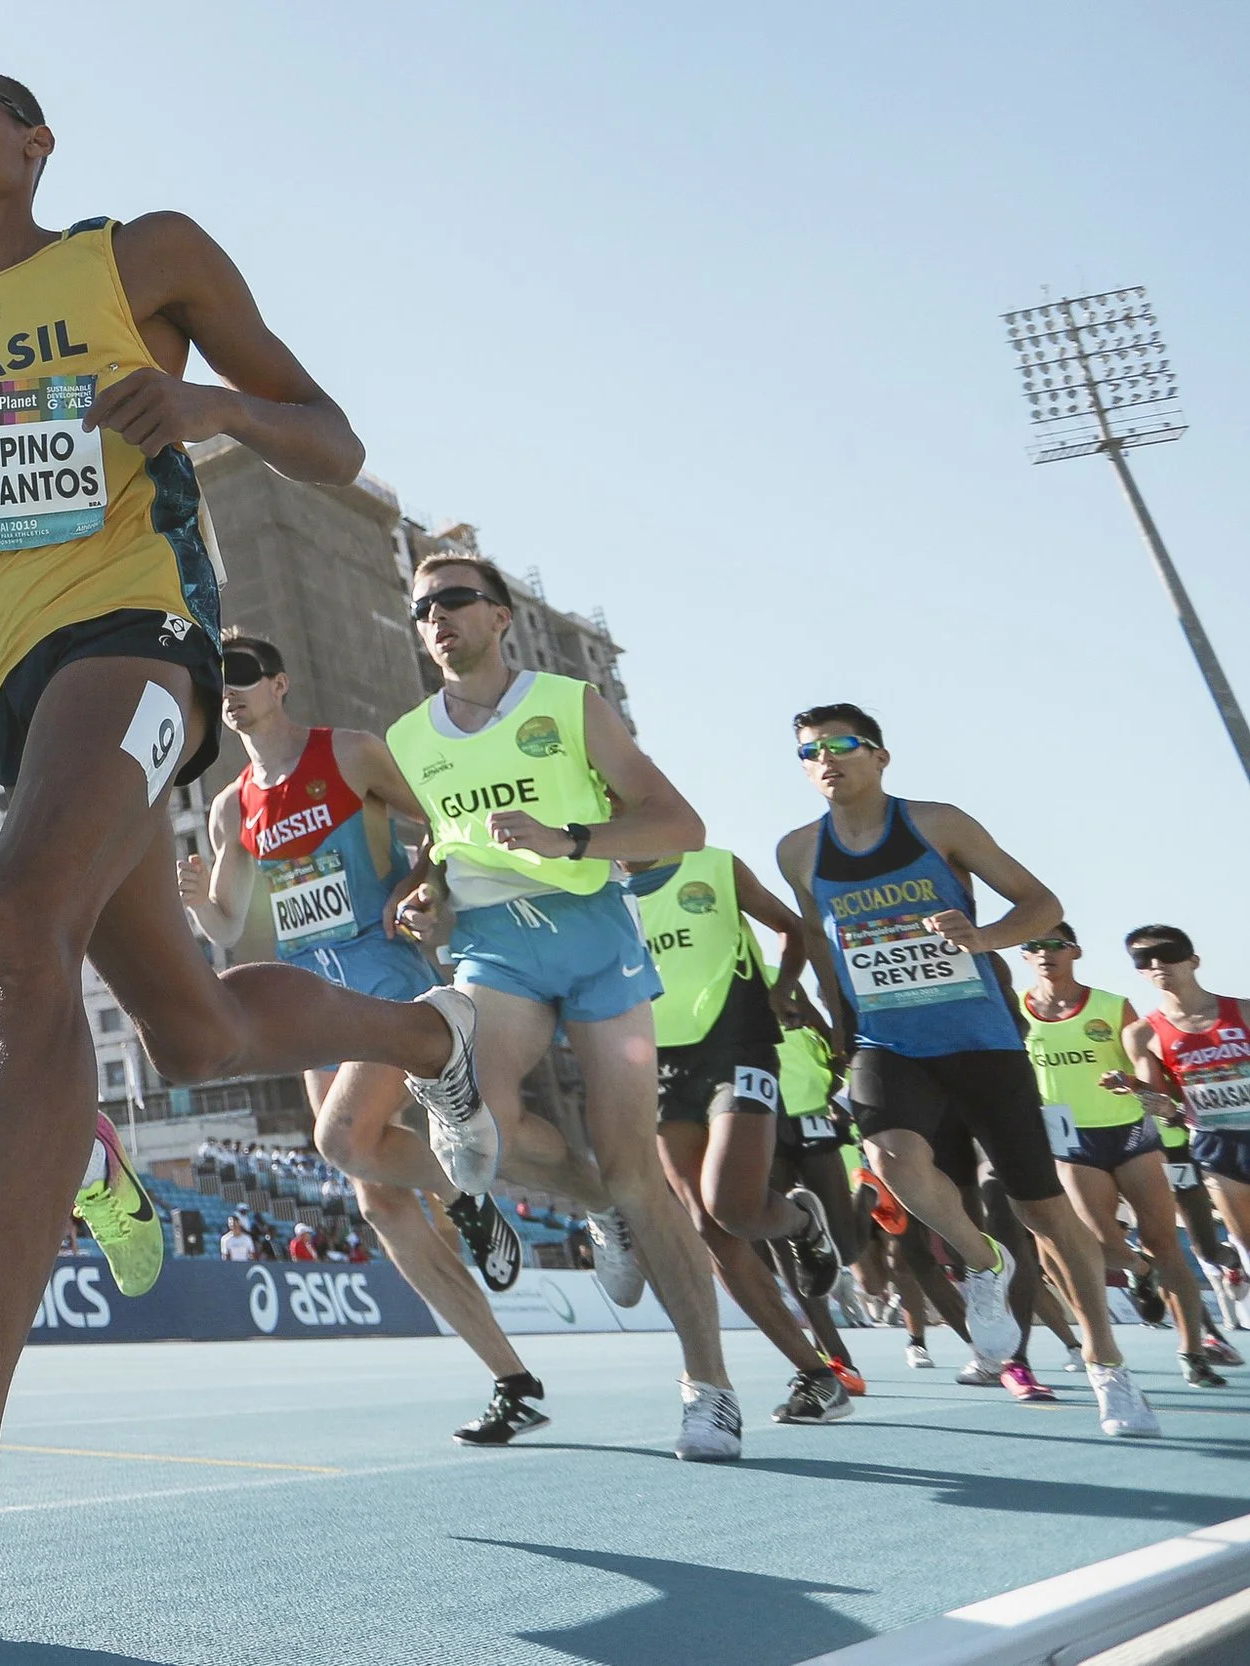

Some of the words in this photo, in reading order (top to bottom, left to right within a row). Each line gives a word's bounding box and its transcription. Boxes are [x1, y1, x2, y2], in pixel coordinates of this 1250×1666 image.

[46, 384, 92, 393] SUSTAINABLE
[46, 391, 92, 400] DEVELOPMENT
[47, 397, 93, 410] GALS
[10, 519, 38, 531] 2019
[15, 529, 50, 538] ATHLETICS
[153, 718, 175, 769] 9
[441, 778, 539, 819] GUIDE
[256, 804, 333, 856] RUSSIA
[276, 881, 351, 932] RUDAKOV
[831, 879, 938, 919] ECUADOR
[851, 940, 961, 969] CASTRO
[871, 961, 954, 986] REYES
[1034, 1050, 1098, 1068] GUIDE
[1177, 1042, 1250, 1067] JAPAN
[740, 1073, 774, 1099] 10
[1187, 1084, 1250, 1111] KARASA
[1172, 1165, 1186, 1183] 7
